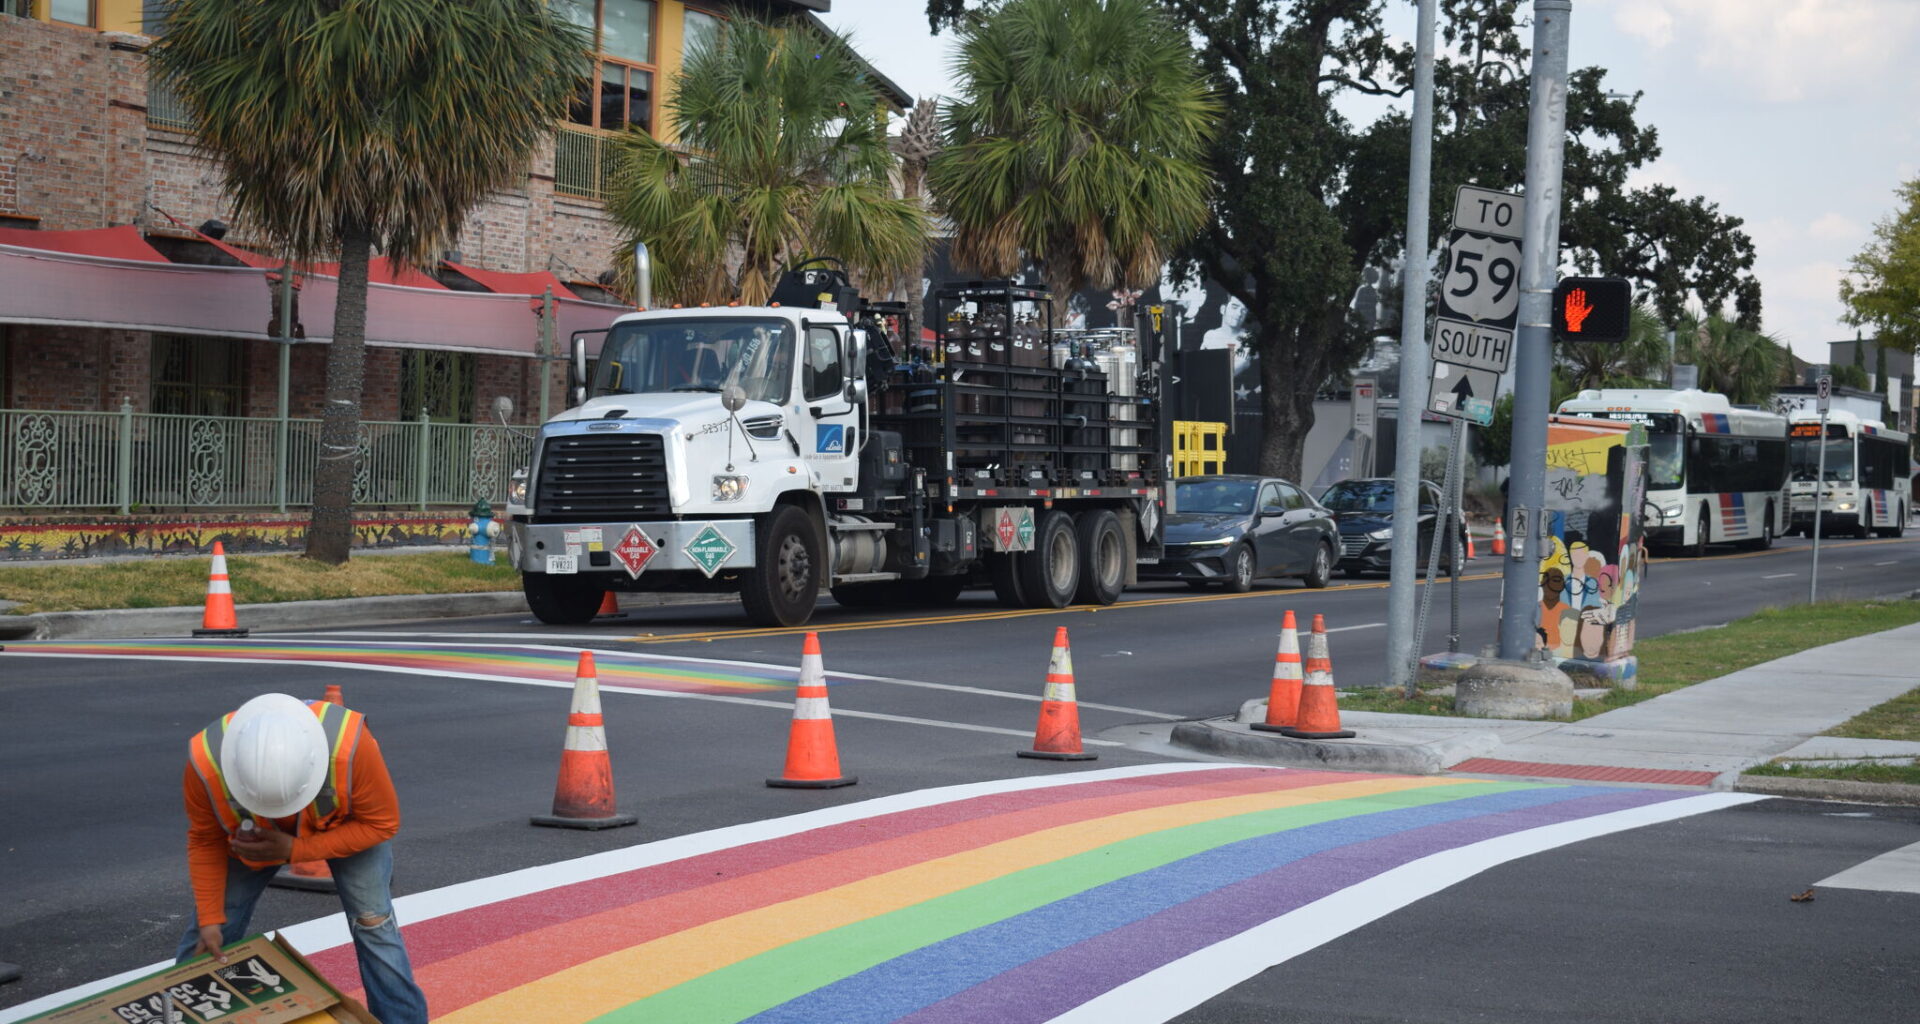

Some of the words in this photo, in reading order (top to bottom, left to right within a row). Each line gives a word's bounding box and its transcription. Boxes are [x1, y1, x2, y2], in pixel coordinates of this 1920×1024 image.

[1478, 199, 1513, 227] TO
[1450, 250, 1516, 304] 59
[1438, 329, 1507, 363] SOUTH
[632, 559, 638, 568] 2
[170, 983, 201, 1005] 55
[118, 1002, 153, 1024] 55
